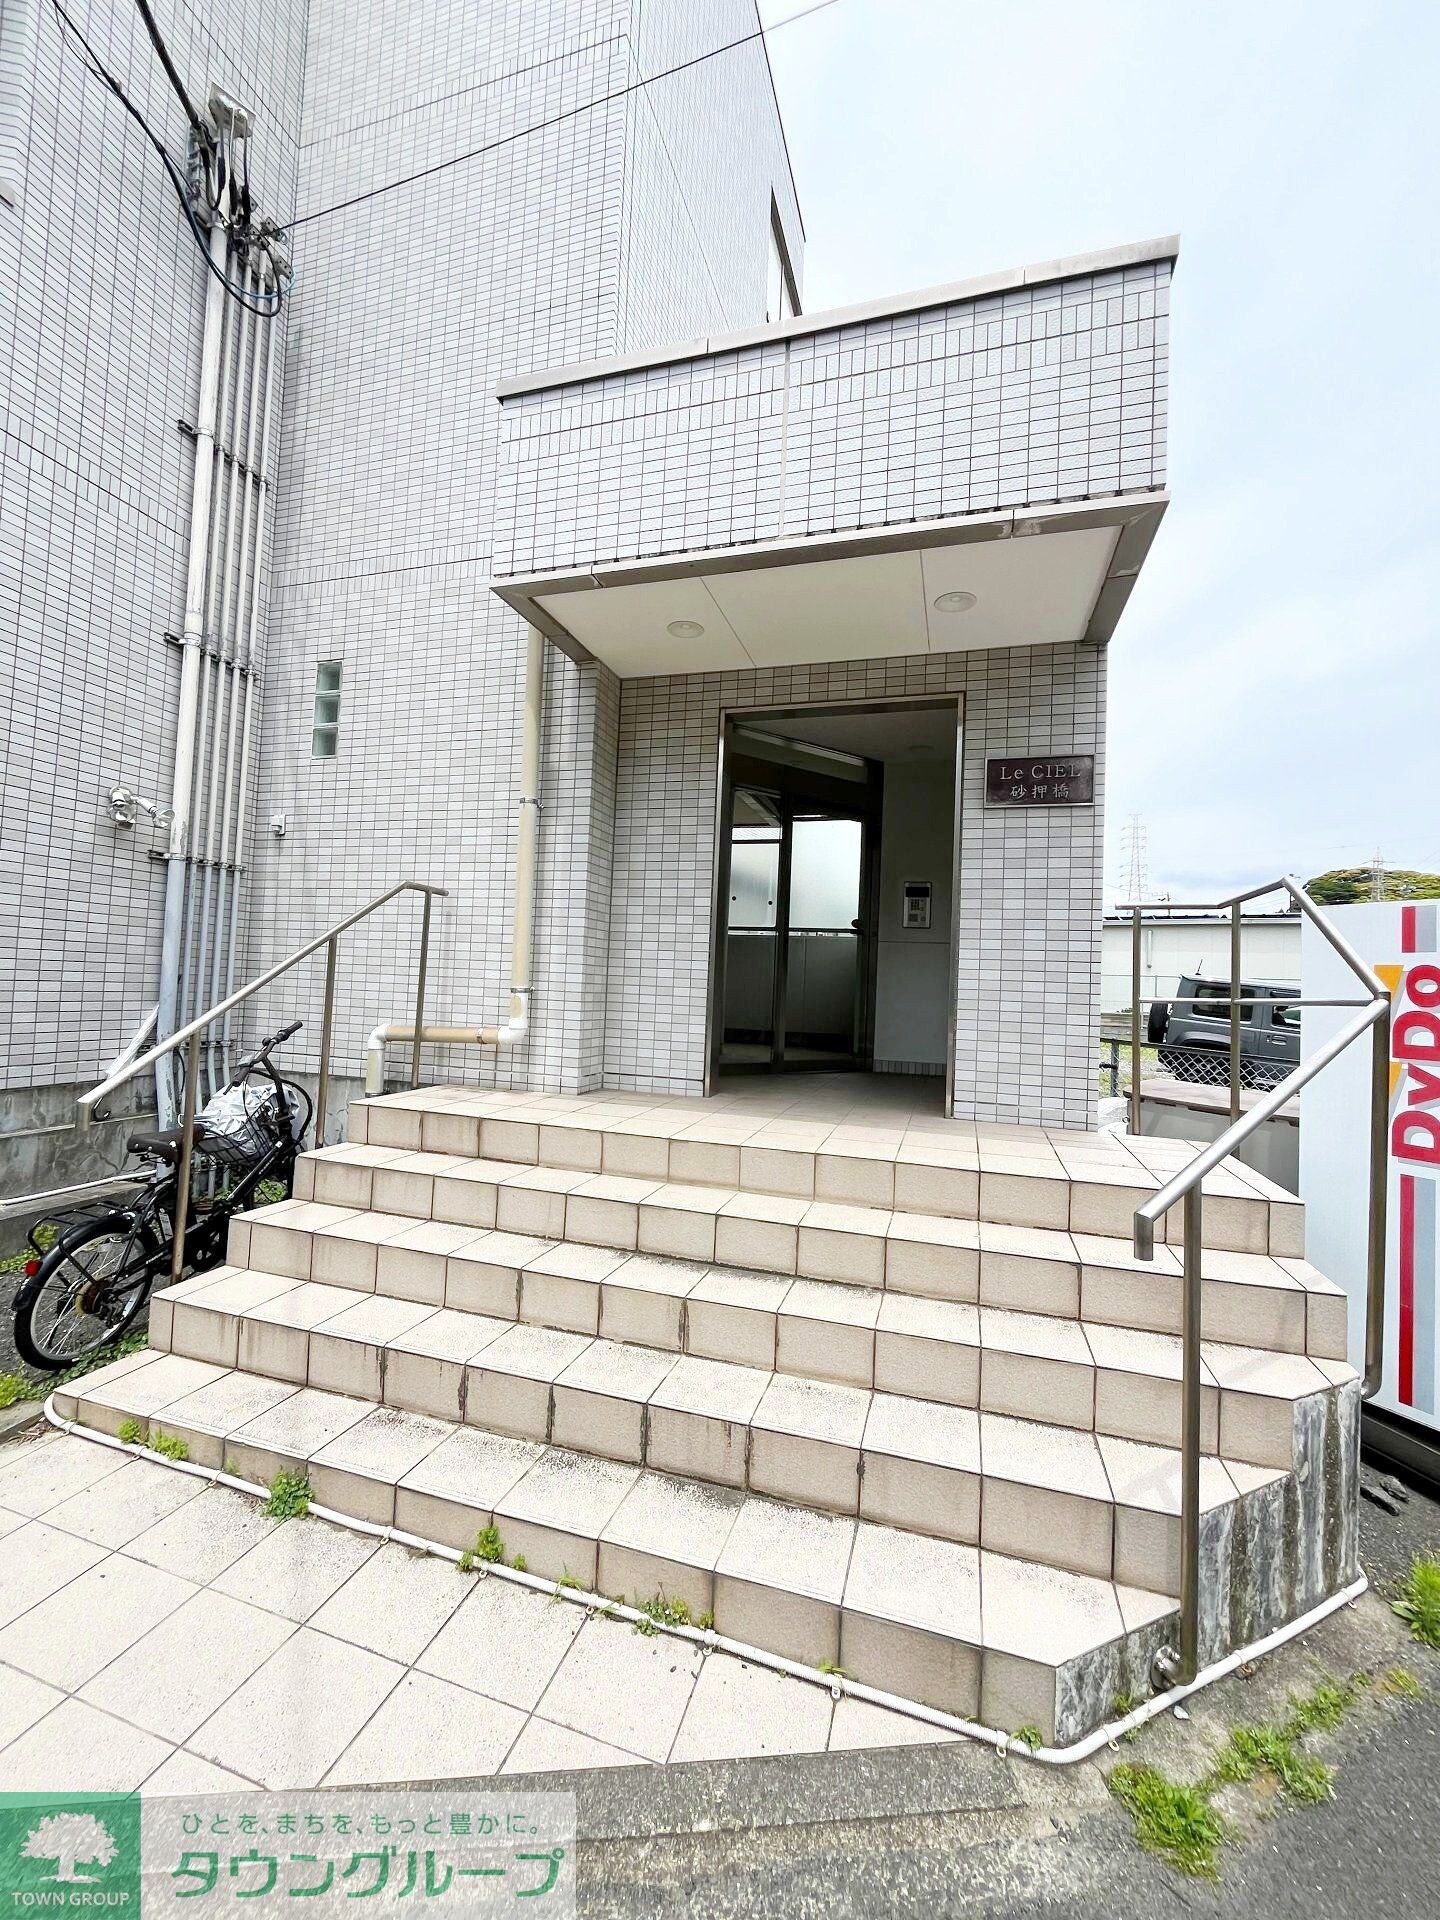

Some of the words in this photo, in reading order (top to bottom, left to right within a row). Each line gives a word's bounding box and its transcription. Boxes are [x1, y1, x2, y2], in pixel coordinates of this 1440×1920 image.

[1000, 766, 1024, 780] Le
[1031, 764, 1081, 779] CIEL
[1010, 782, 1070, 799] 砂押橋
